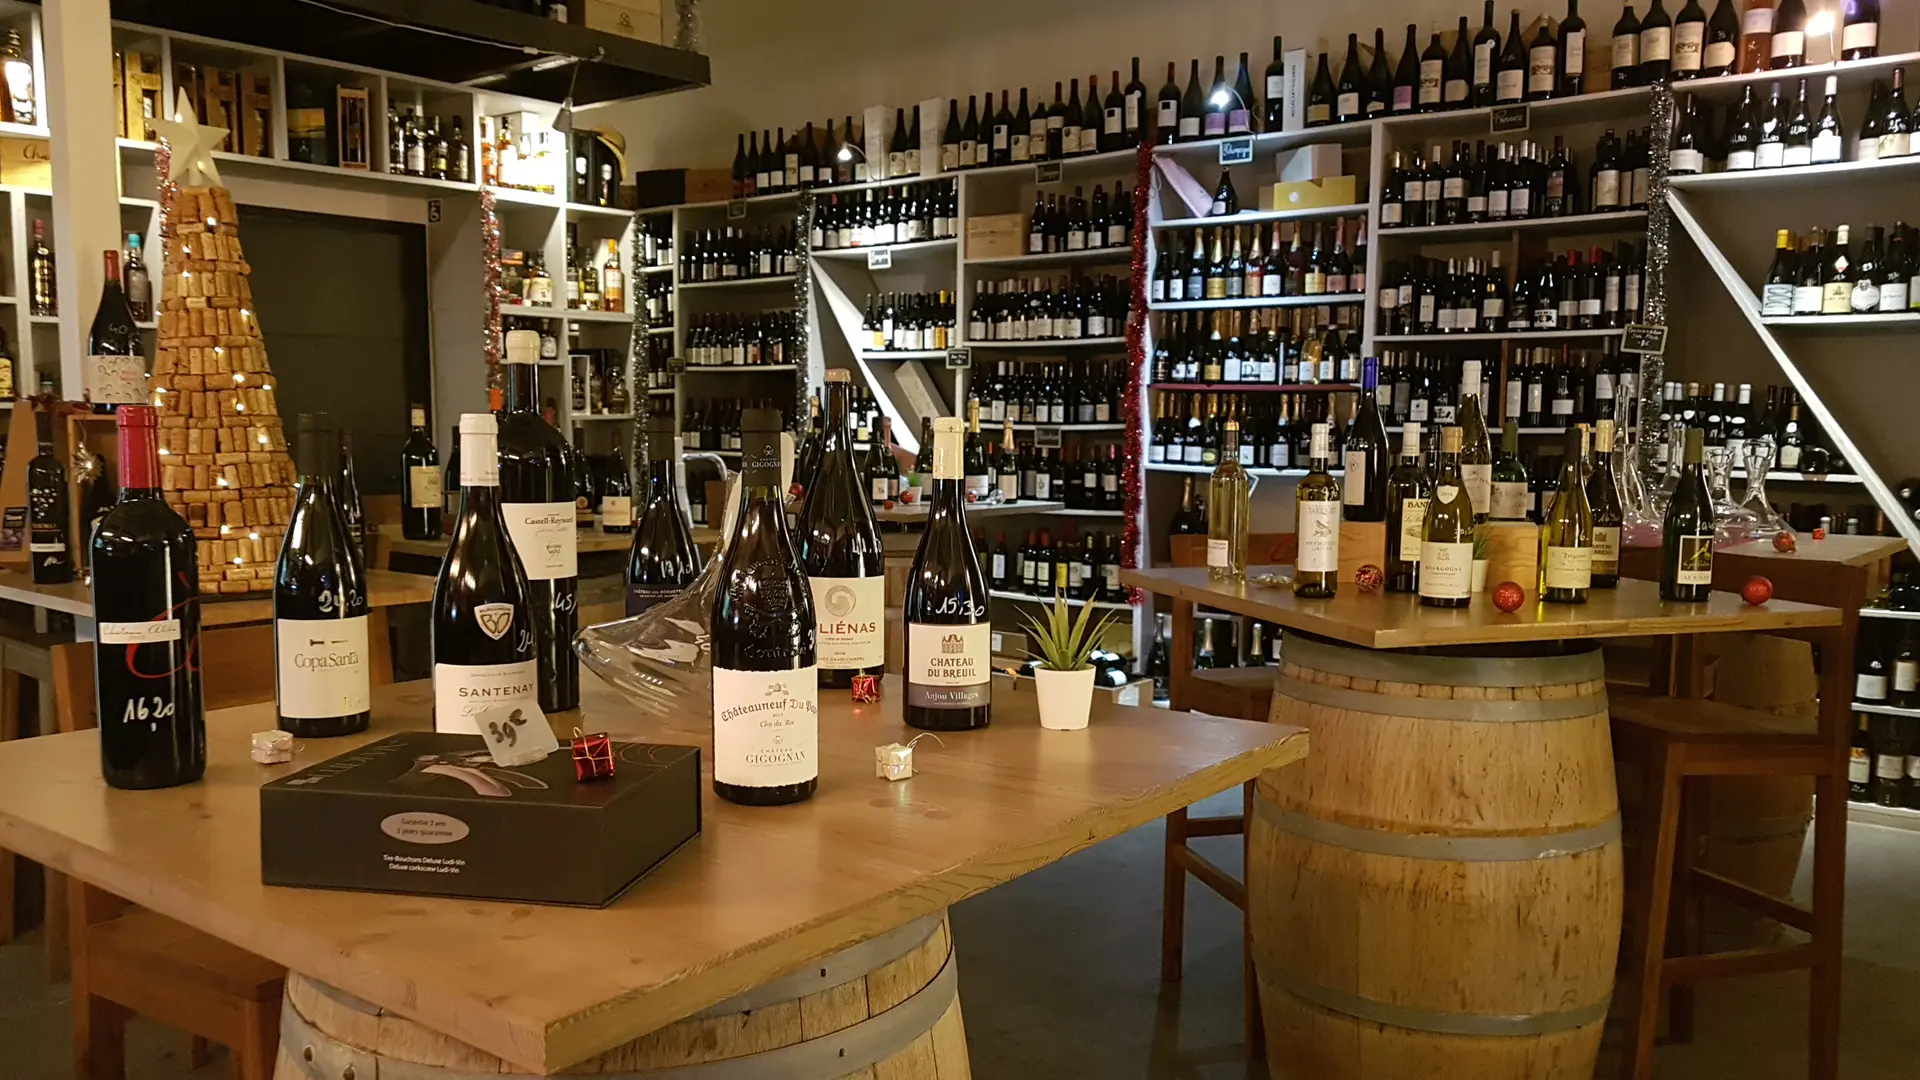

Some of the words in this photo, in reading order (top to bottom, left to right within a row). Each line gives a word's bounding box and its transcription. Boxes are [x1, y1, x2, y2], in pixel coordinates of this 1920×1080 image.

[1407, 500, 1429, 509] BAN
[935, 596, 986, 617] 15,30
[819, 620, 876, 634] LIÉNAS
[930, 657, 974, 667] CHATEAU
[927, 668, 940, 678] DU
[943, 667, 977, 679] BREUIL
[458, 682, 534, 698] SANTENAY
[924, 690, 947, 702] Anjou
[949, 690, 979, 701] Villages
[720, 698, 787, 723] Châteauneuf
[759, 719, 773, 729] Clos
[422, 856, 442, 865] Deluxe
[442, 858, 466, 867] Ludi-Vin
[388, 863, 409, 872] Deluxe
[436, 866, 460, 875] Ludi-Vin
